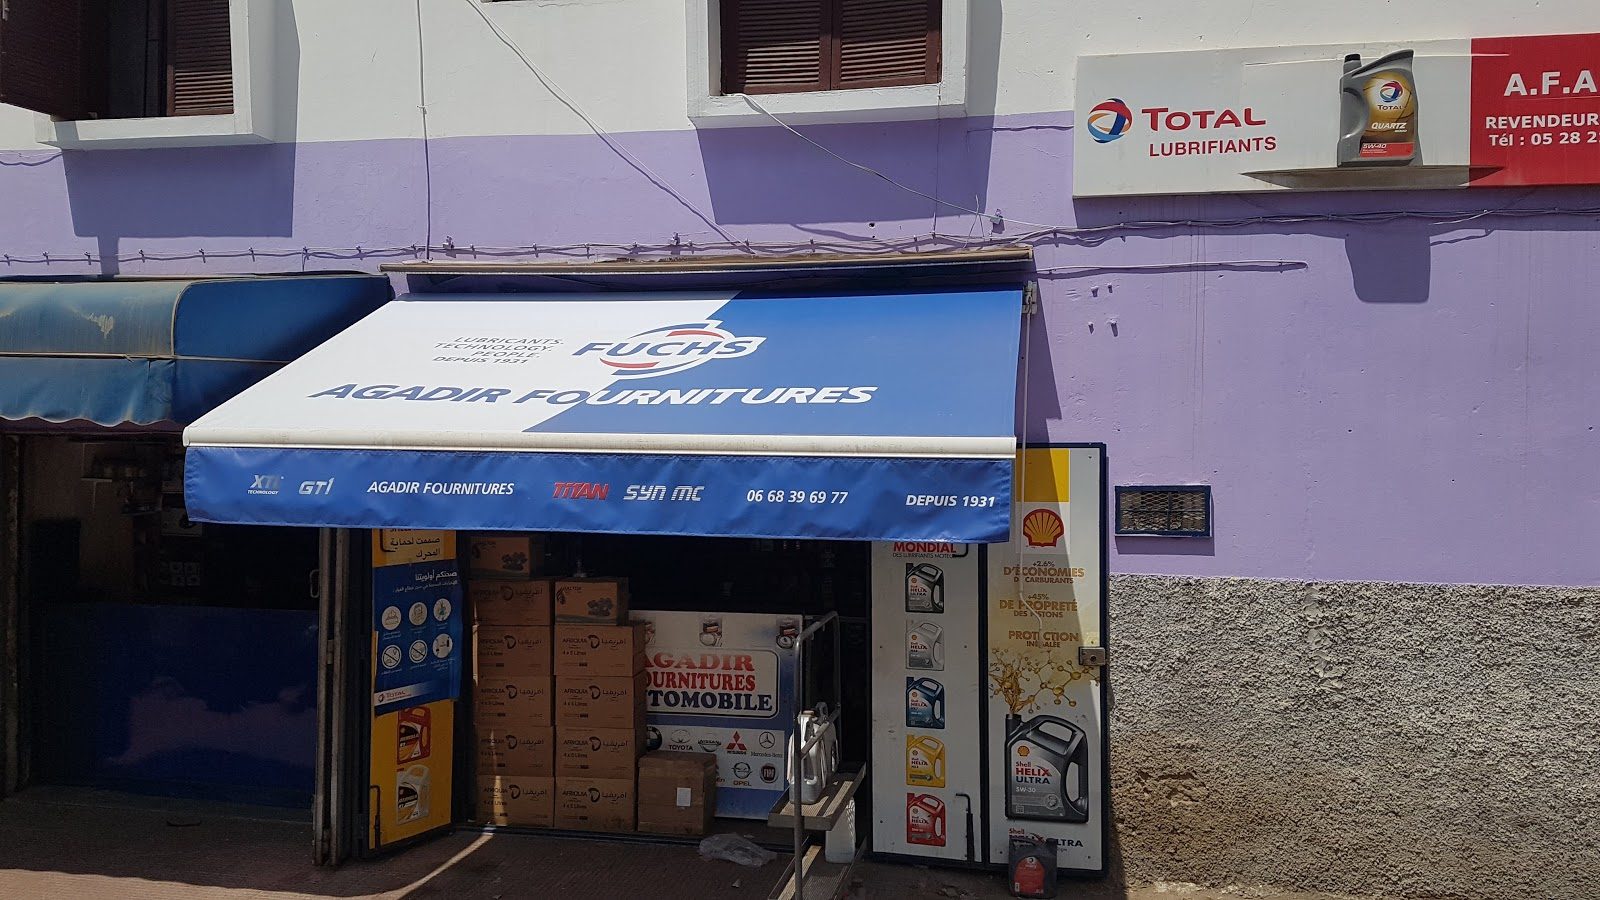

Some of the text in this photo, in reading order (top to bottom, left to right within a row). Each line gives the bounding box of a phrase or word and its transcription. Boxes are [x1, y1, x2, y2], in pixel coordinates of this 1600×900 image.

[1141, 107, 1267, 132] TOTAL
[1371, 122, 1407, 130] QUARTZ
[1488, 133, 1514, 147] Tél
[1530, 132, 1553, 146] 05
[1559, 131, 1581, 145] 28
[1586, 130, 1600, 144] 2
[1149, 136, 1277, 157] LUBRIFIANTS
[572, 340, 753, 357] FUCHS
[307, 383, 877, 405] AGADIR FOURNITURES
[367, 481, 515, 495] AGADIR FOURNITURES
[747, 489, 848, 504] 06 68 39 69 77
[905, 494, 995, 507] DEPUIS 1931
[894, 541, 957, 553] MONDIAL
[1025, 576, 1074, 584] CARBURANTS
[999, 598, 1078, 611] DE PROPRETÉ
[648, 690, 772, 711] TOMOBILE
[1015, 767, 1052, 777] HELIX
[1016, 776, 1050, 784] ULTRA
[1009, 827, 1025, 835] Shell
[1057, 839, 1083, 847] LTRA
